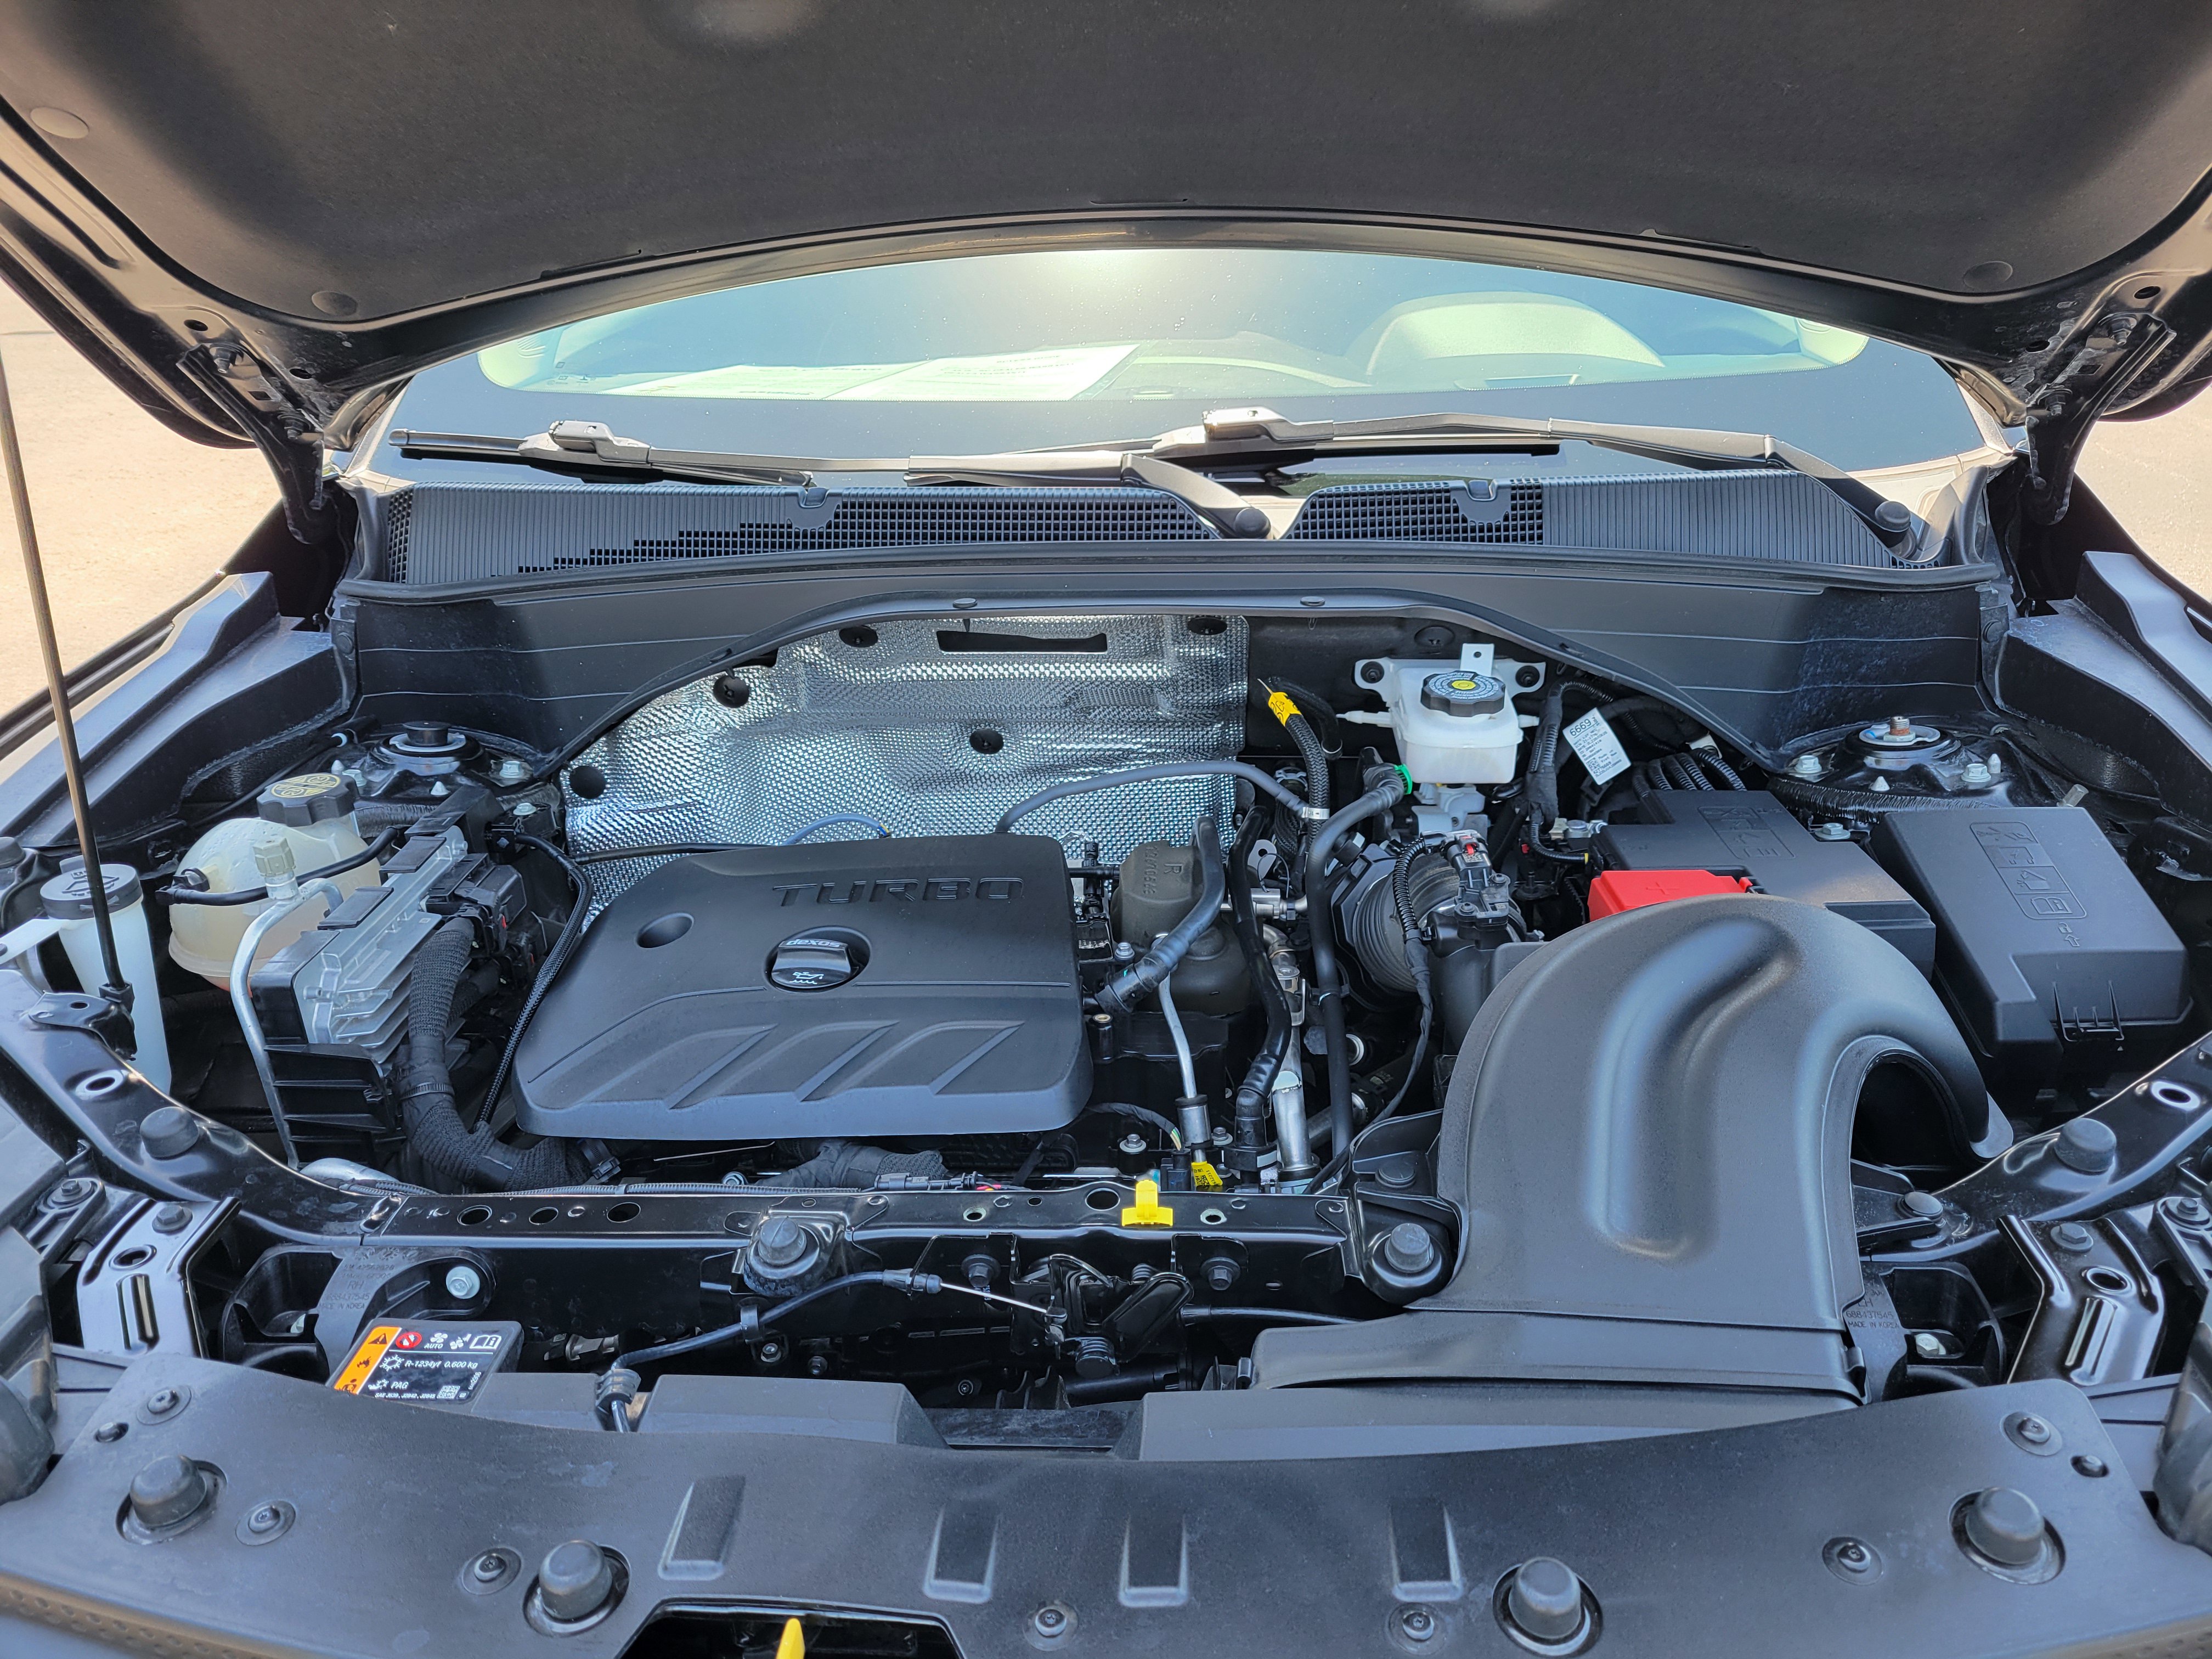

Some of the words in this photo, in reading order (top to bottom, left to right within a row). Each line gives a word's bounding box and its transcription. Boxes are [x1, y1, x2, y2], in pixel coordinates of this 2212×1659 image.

[1570, 719, 1592, 736] 6669
[1164, 864, 1184, 874] R
[772, 877, 1024, 907] TURBO
[786, 939, 841, 947] dexos
[346, 1280, 365, 1290] RH
[1858, 1297, 1874, 1307] LH
[1846, 1310, 1894, 1319] 688437545
[467, 1361, 478, 1369] kg
